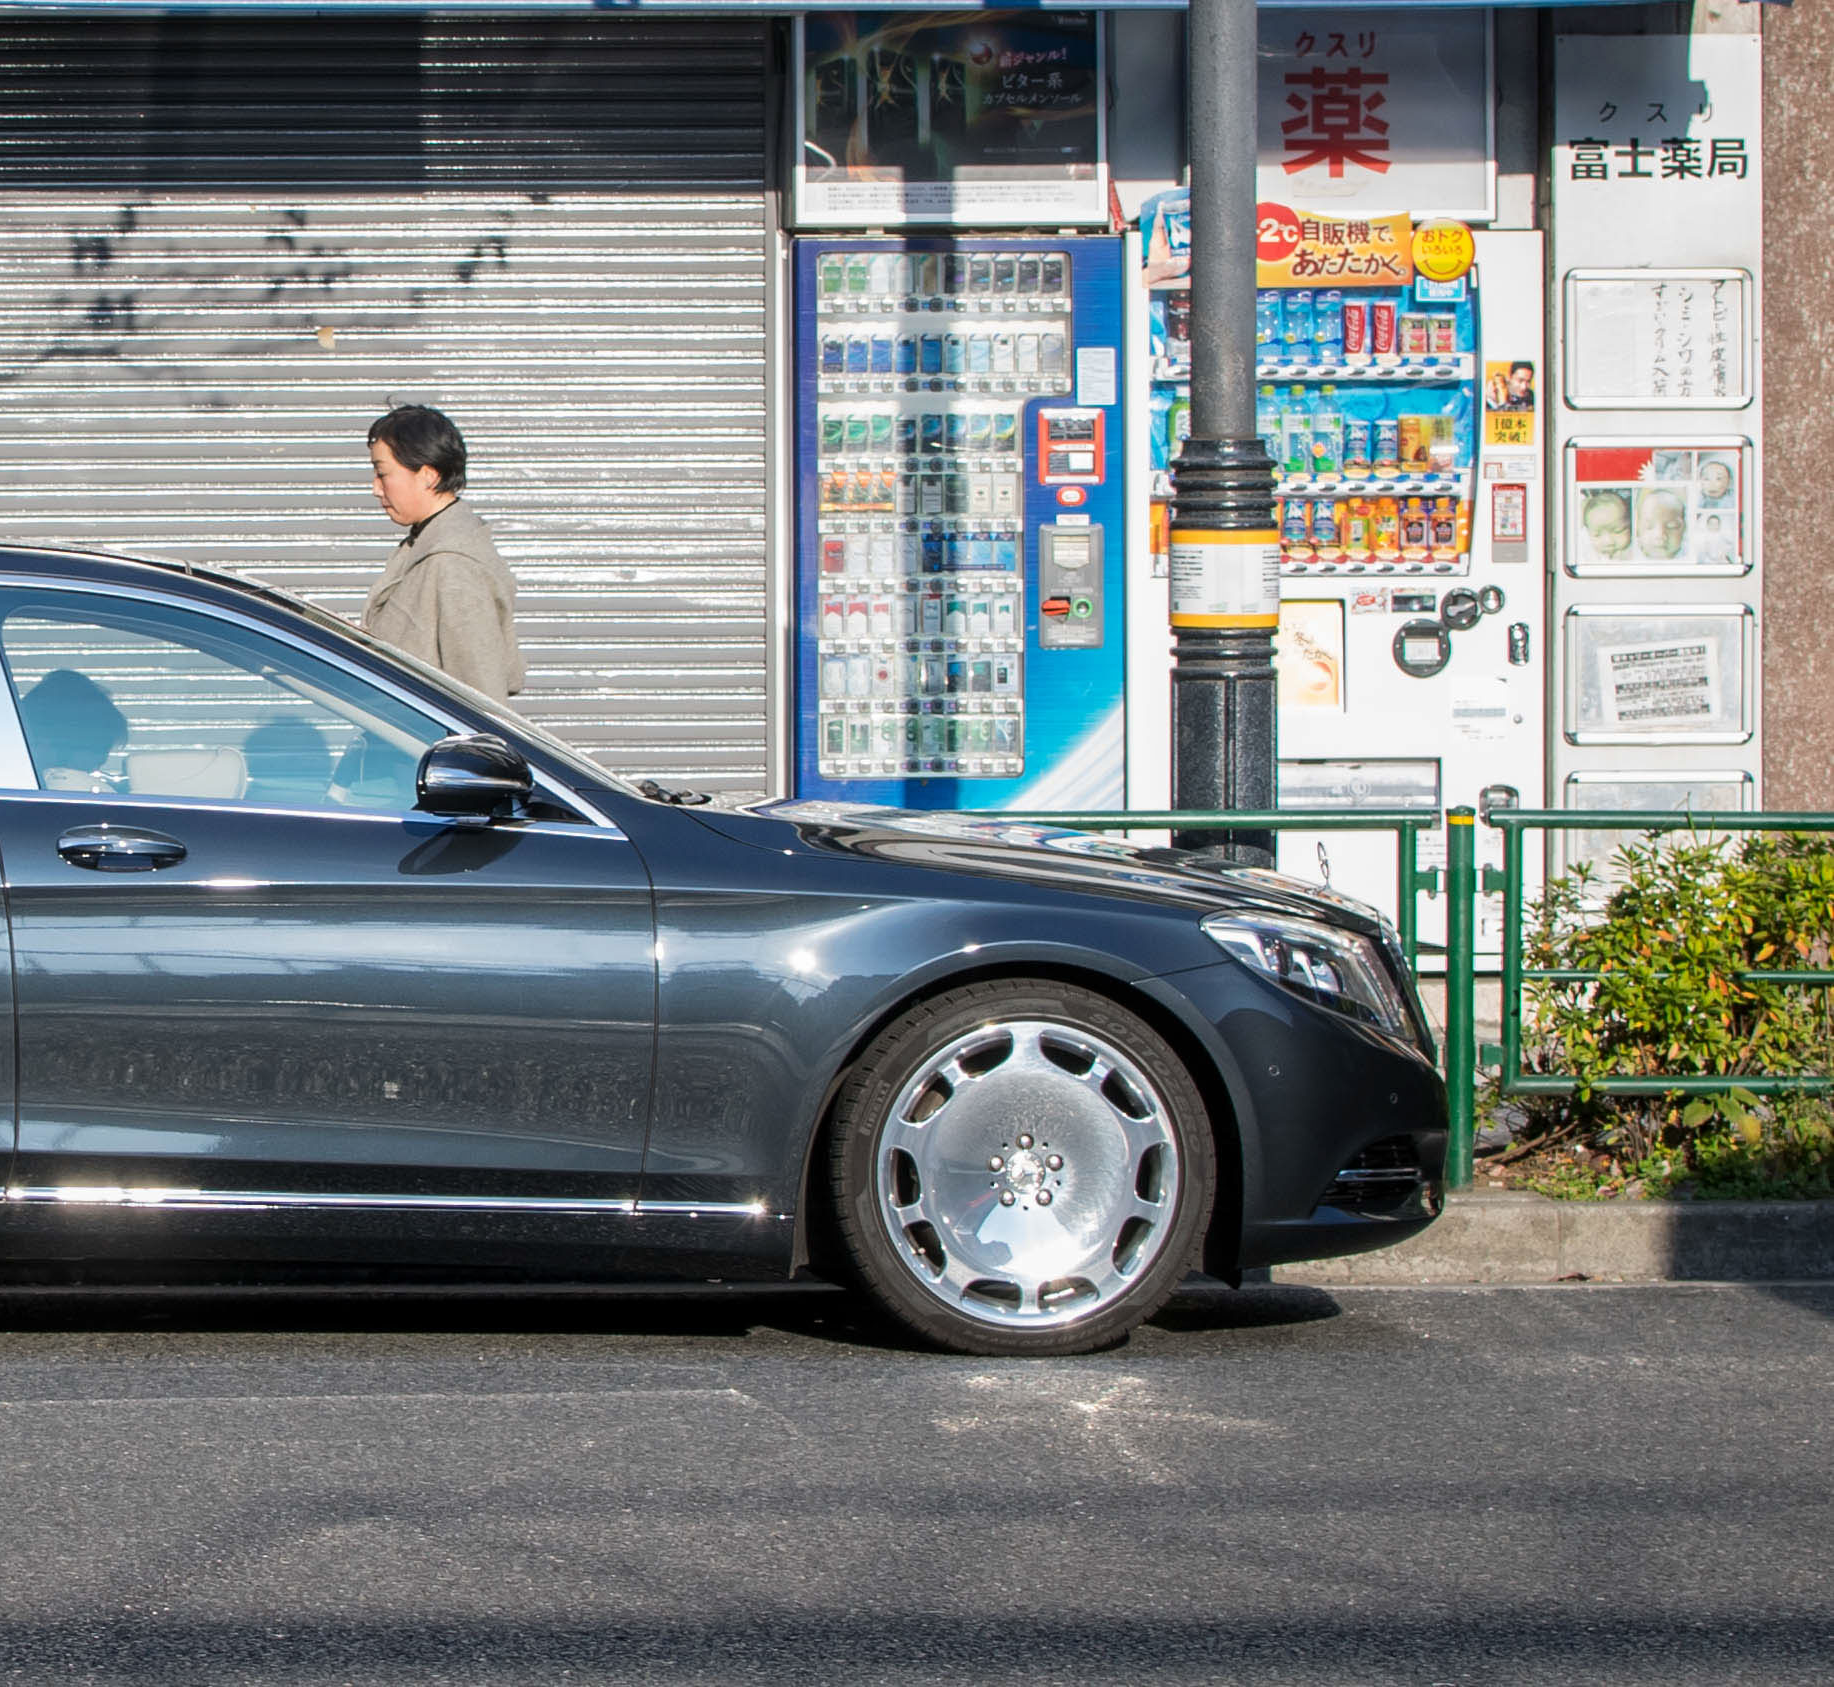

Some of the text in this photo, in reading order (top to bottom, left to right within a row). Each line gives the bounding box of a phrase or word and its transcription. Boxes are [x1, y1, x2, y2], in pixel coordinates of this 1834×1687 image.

[1295, 31, 1377, 58] クスリ
[1281, 67, 1393, 179] 薬
[1599, 102, 1713, 123] クスリ
[1568, 137, 1749, 181] 富士薬局
[1422, 230, 1464, 243] おトク
